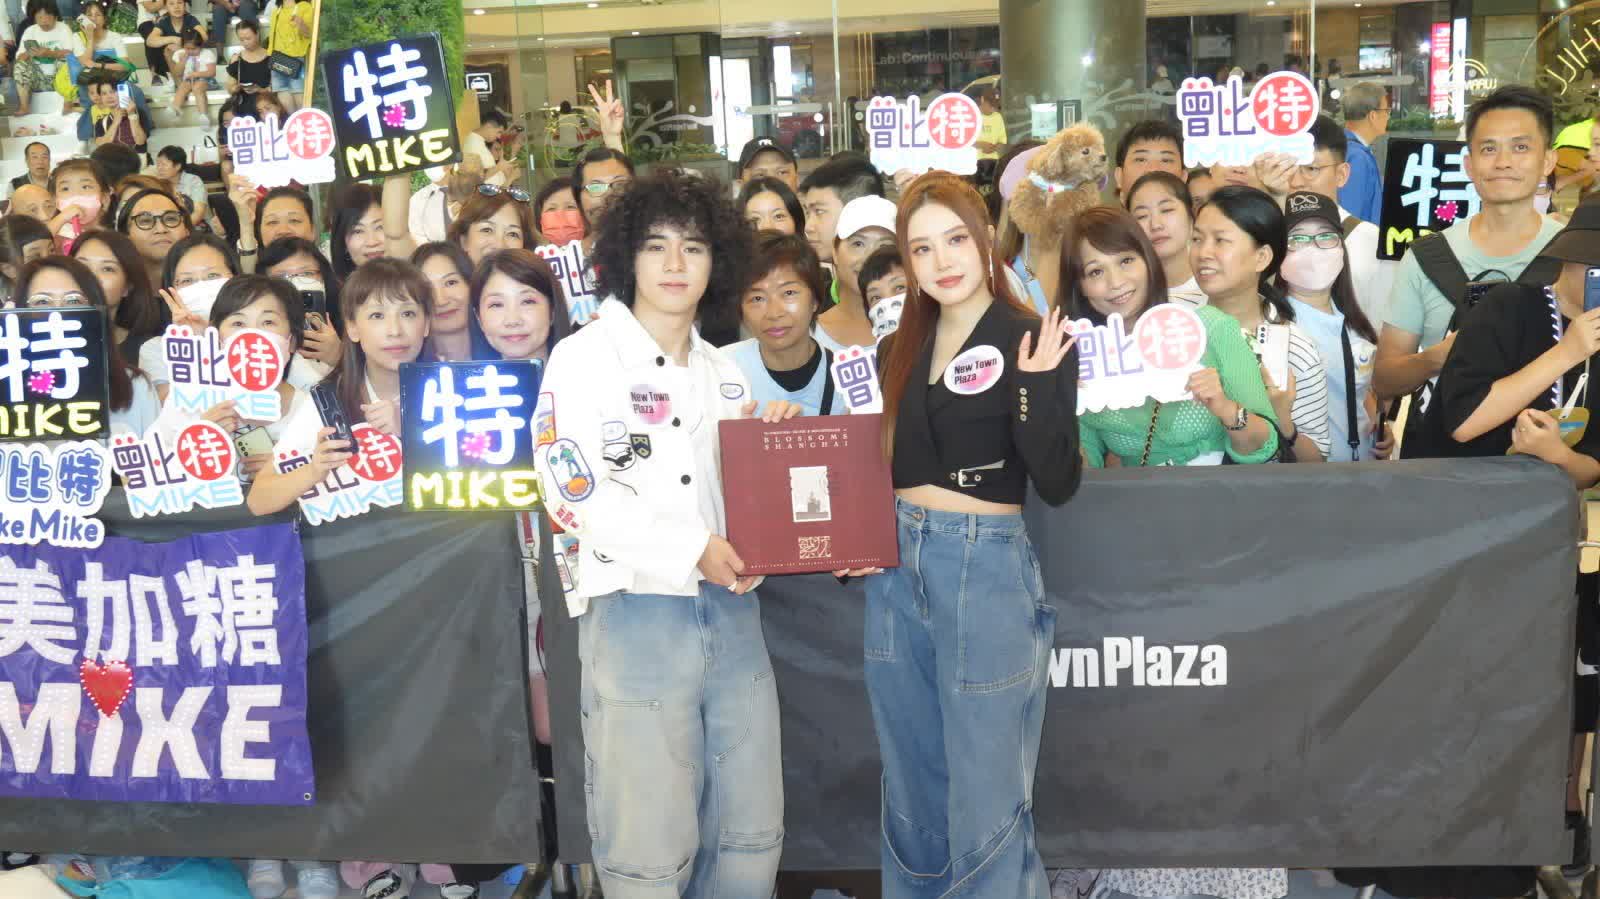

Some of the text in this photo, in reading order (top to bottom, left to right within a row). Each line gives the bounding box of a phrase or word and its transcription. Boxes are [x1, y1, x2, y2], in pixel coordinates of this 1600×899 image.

[343, 43, 432, 138] 特
[1182, 79, 1310, 136] 曾比特
[232, 114, 331, 165] 曾比特
[871, 99, 975, 148] 曾比特
[346, 129, 453, 178] MIKE
[1401, 143, 1480, 226] 特
[0, 312, 89, 402] 特
[166, 328, 277, 387] 曾比特
[954, 358, 997, 374] New Town
[1065, 313, 1198, 381] 曾比特
[174, 389, 278, 417] MIKE
[630, 391, 670, 402] New Town
[836, 349, 878, 408] 曾
[954, 373, 977, 384] Plaza
[421, 364, 526, 467] 特
[633, 403, 655, 414] Plaza
[112, 429, 229, 489] 曾比特
[764, 434, 848, 444] BLOSSOMS
[764, 440, 848, 450] SHANGHAI
[0, 448, 104, 506] 比特
[130, 479, 241, 515] MIKE
[411, 470, 538, 509] MIKE
[0, 554, 281, 668] 美加糖
